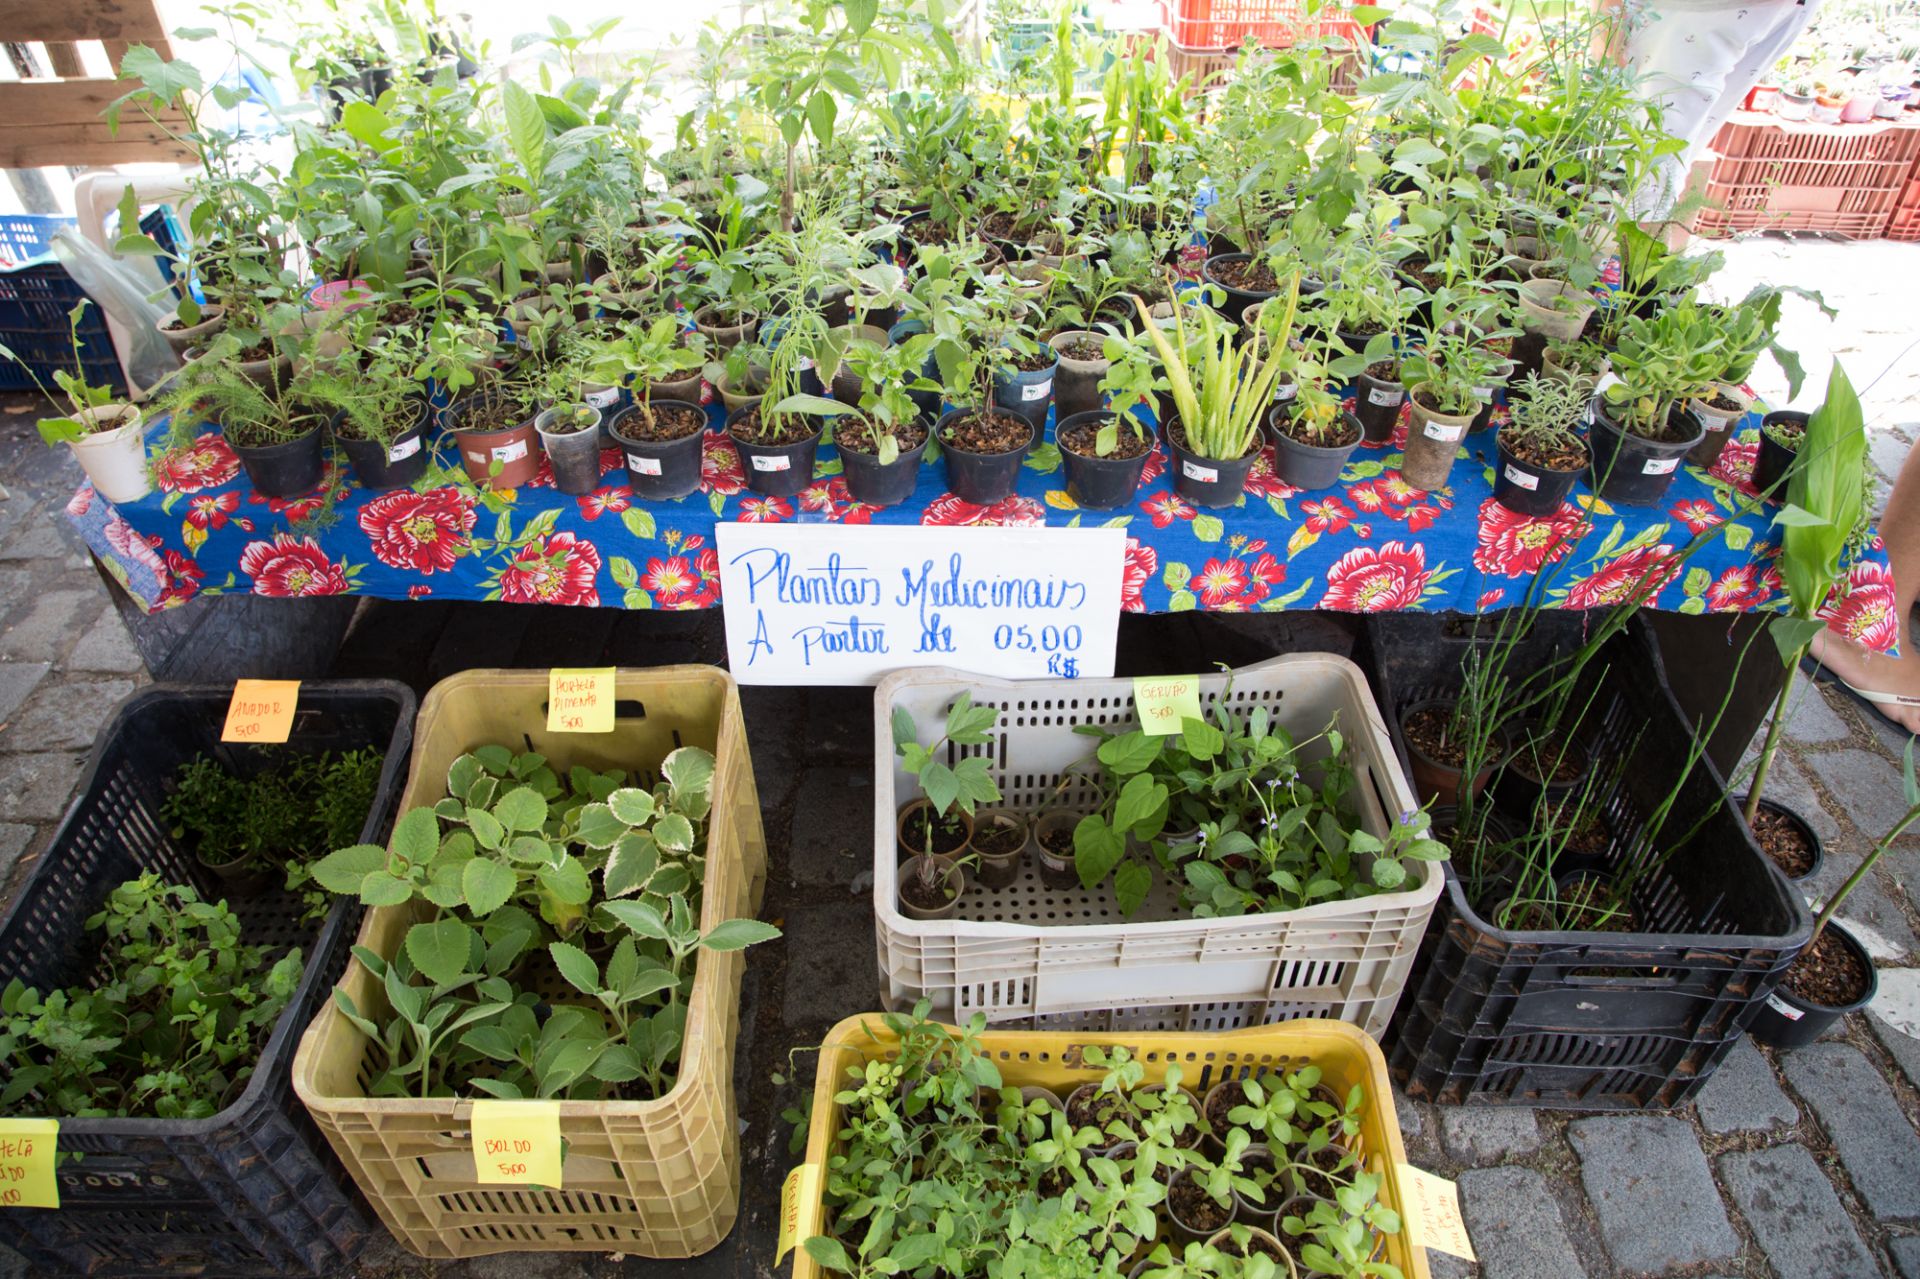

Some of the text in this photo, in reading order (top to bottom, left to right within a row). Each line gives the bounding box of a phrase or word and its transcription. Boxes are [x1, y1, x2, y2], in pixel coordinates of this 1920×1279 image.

[730, 548, 1086, 618] Plantas Medicinais
[747, 609, 774, 666] A
[913, 612, 957, 653] de
